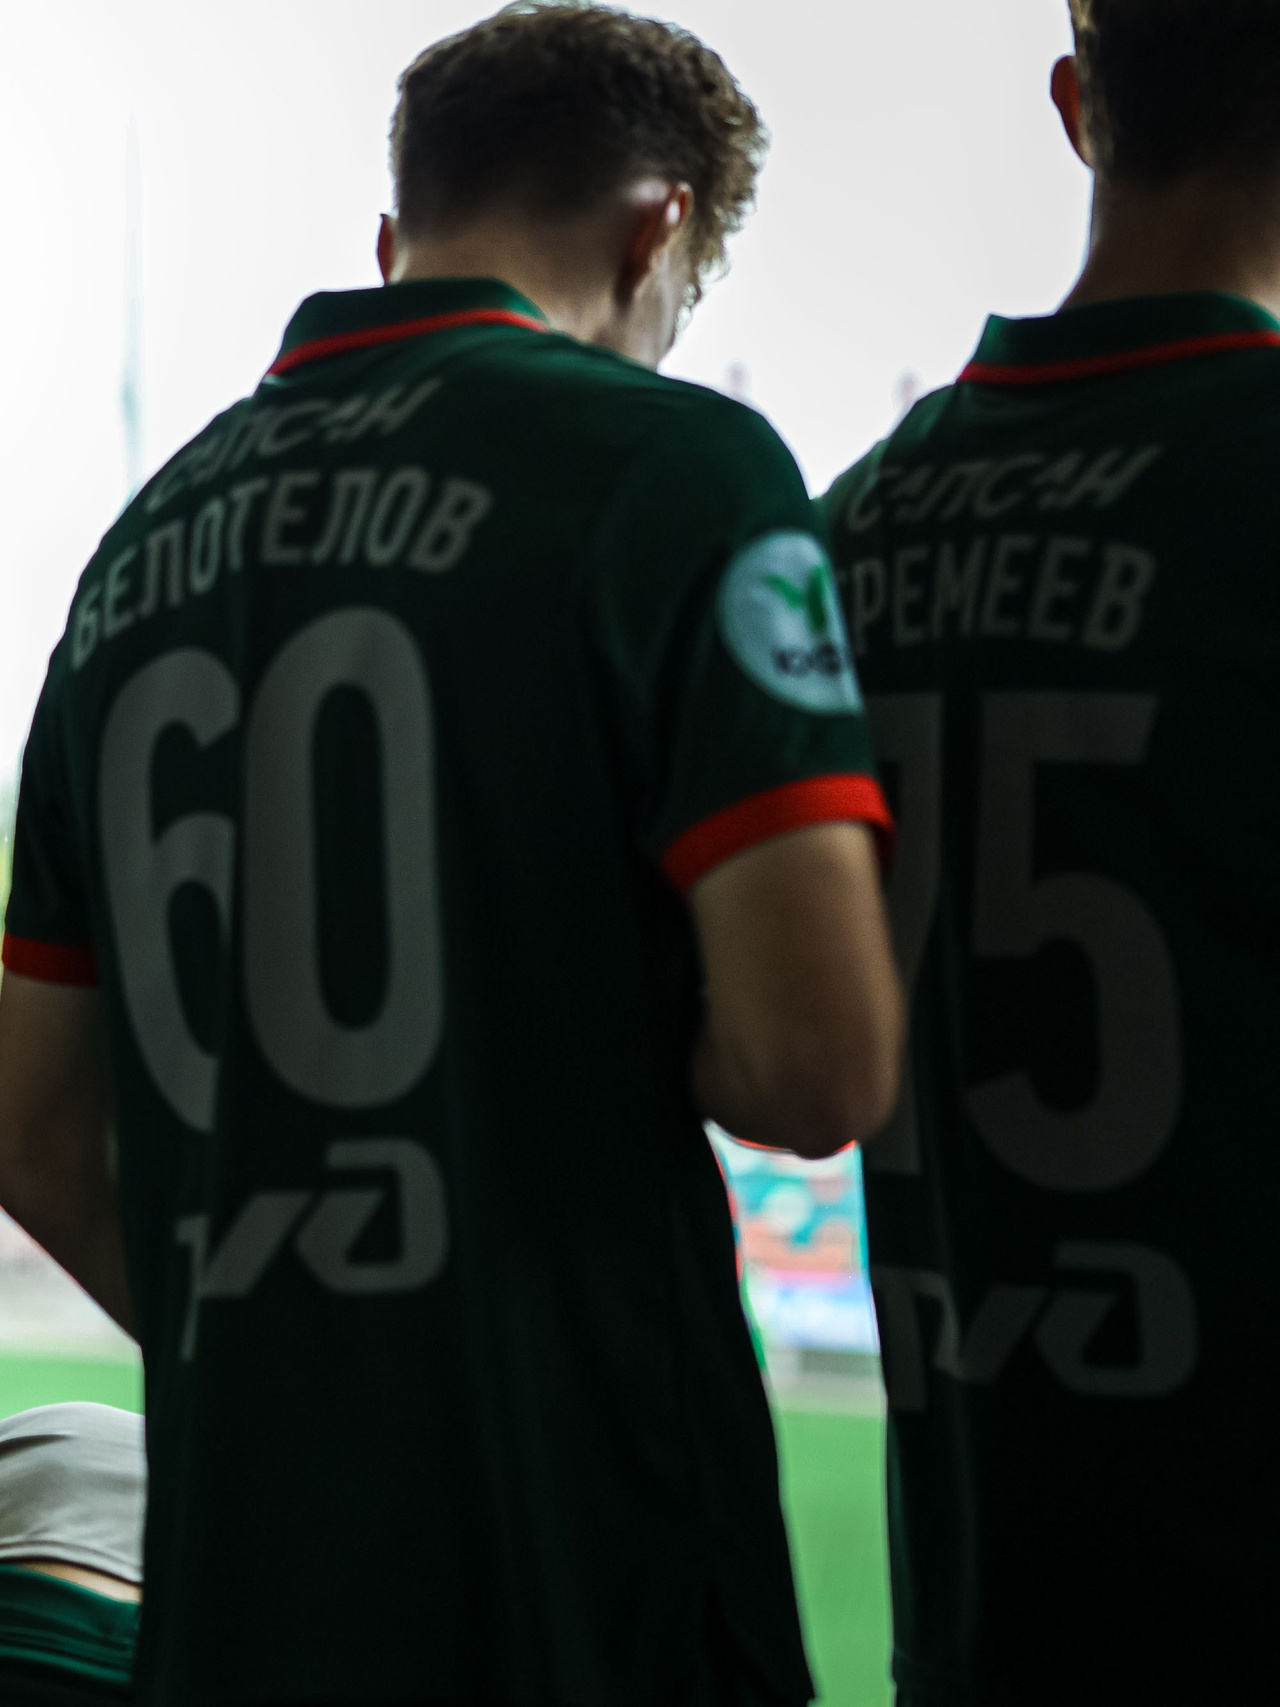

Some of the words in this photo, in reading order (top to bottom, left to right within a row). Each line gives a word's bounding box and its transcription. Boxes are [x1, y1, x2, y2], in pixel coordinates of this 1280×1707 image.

[70, 465, 494, 671] БЕЛОТЕЛОВ
[838, 532, 1157, 659] РЕМЕЕВ
[97, 606, 446, 1134] 60
